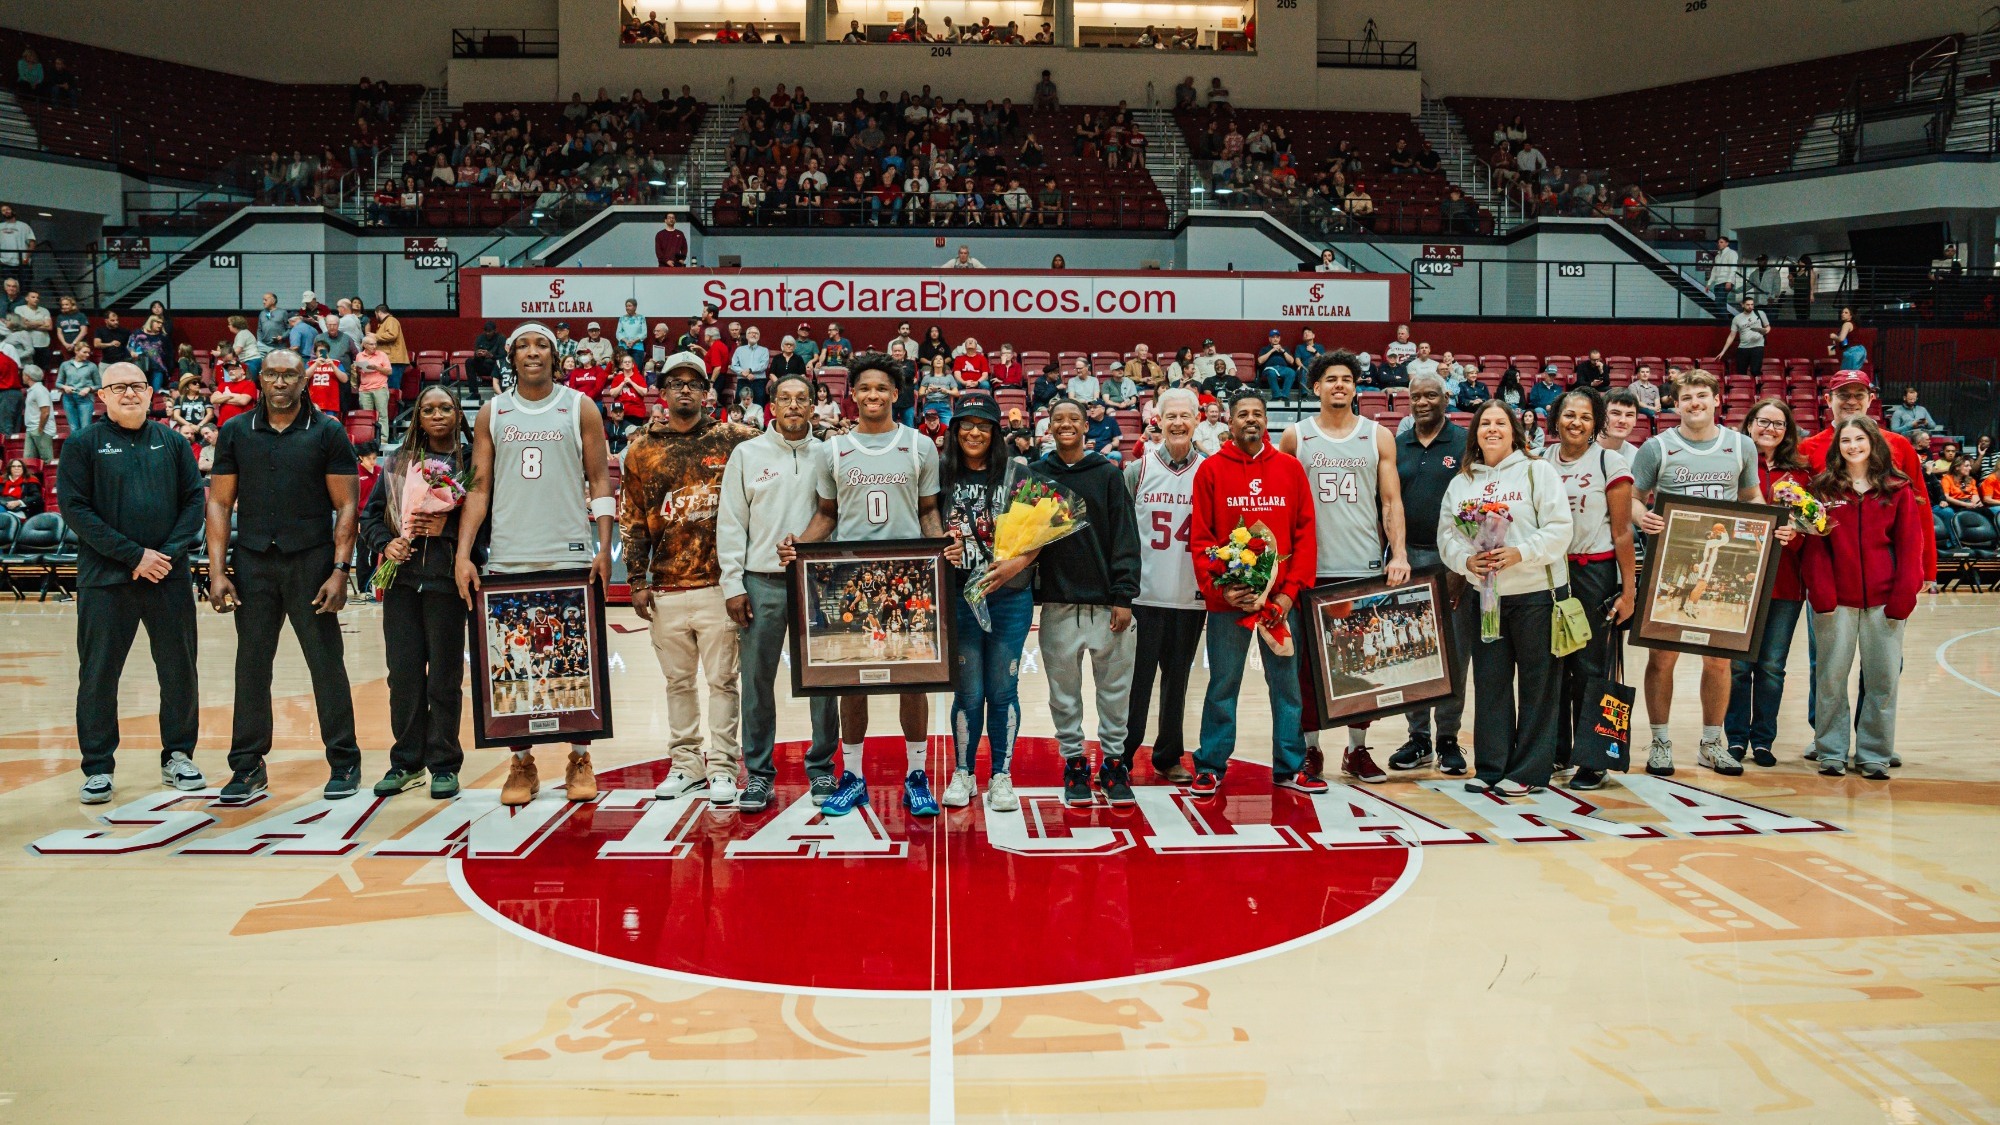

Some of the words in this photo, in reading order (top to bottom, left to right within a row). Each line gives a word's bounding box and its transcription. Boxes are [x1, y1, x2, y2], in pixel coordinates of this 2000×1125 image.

[1277, 0, 1297, 8] 205
[1685, 0, 1707, 12] 206
[931, 47, 952, 57] 204
[213, 256, 236, 267] 101
[416, 256, 441, 267] 102
[1429, 263, 1452, 273] 102
[1560, 265, 1583, 276] 103
[703, 279, 1176, 313] SantaClaraBroncos.com
[521, 302, 556, 313] SANTA
[558, 302, 593, 313] CLARA
[1282, 305, 1315, 317] SANTA
[1317, 305, 1351, 317] CLARA
[312, 373, 330, 387] 22
[502, 424, 564, 442] Broncos
[521, 446, 543, 479] 8
[1310, 451, 1368, 468] Broncos
[847, 467, 908, 486] Broncos
[1673, 466, 1733, 483] Broncos
[1317, 472, 1358, 503] 54
[1143, 492, 1174, 504] SANTA
[1176, 494, 1193, 506] CLA
[1227, 497, 1256, 507] SANTA
[1257, 497, 1286, 507] CLARA
[866, 490, 889, 525] 0
[1151, 510, 1193, 552] 54
[26, 786, 911, 860] SANTA
[986, 774, 1850, 857] CLARA
